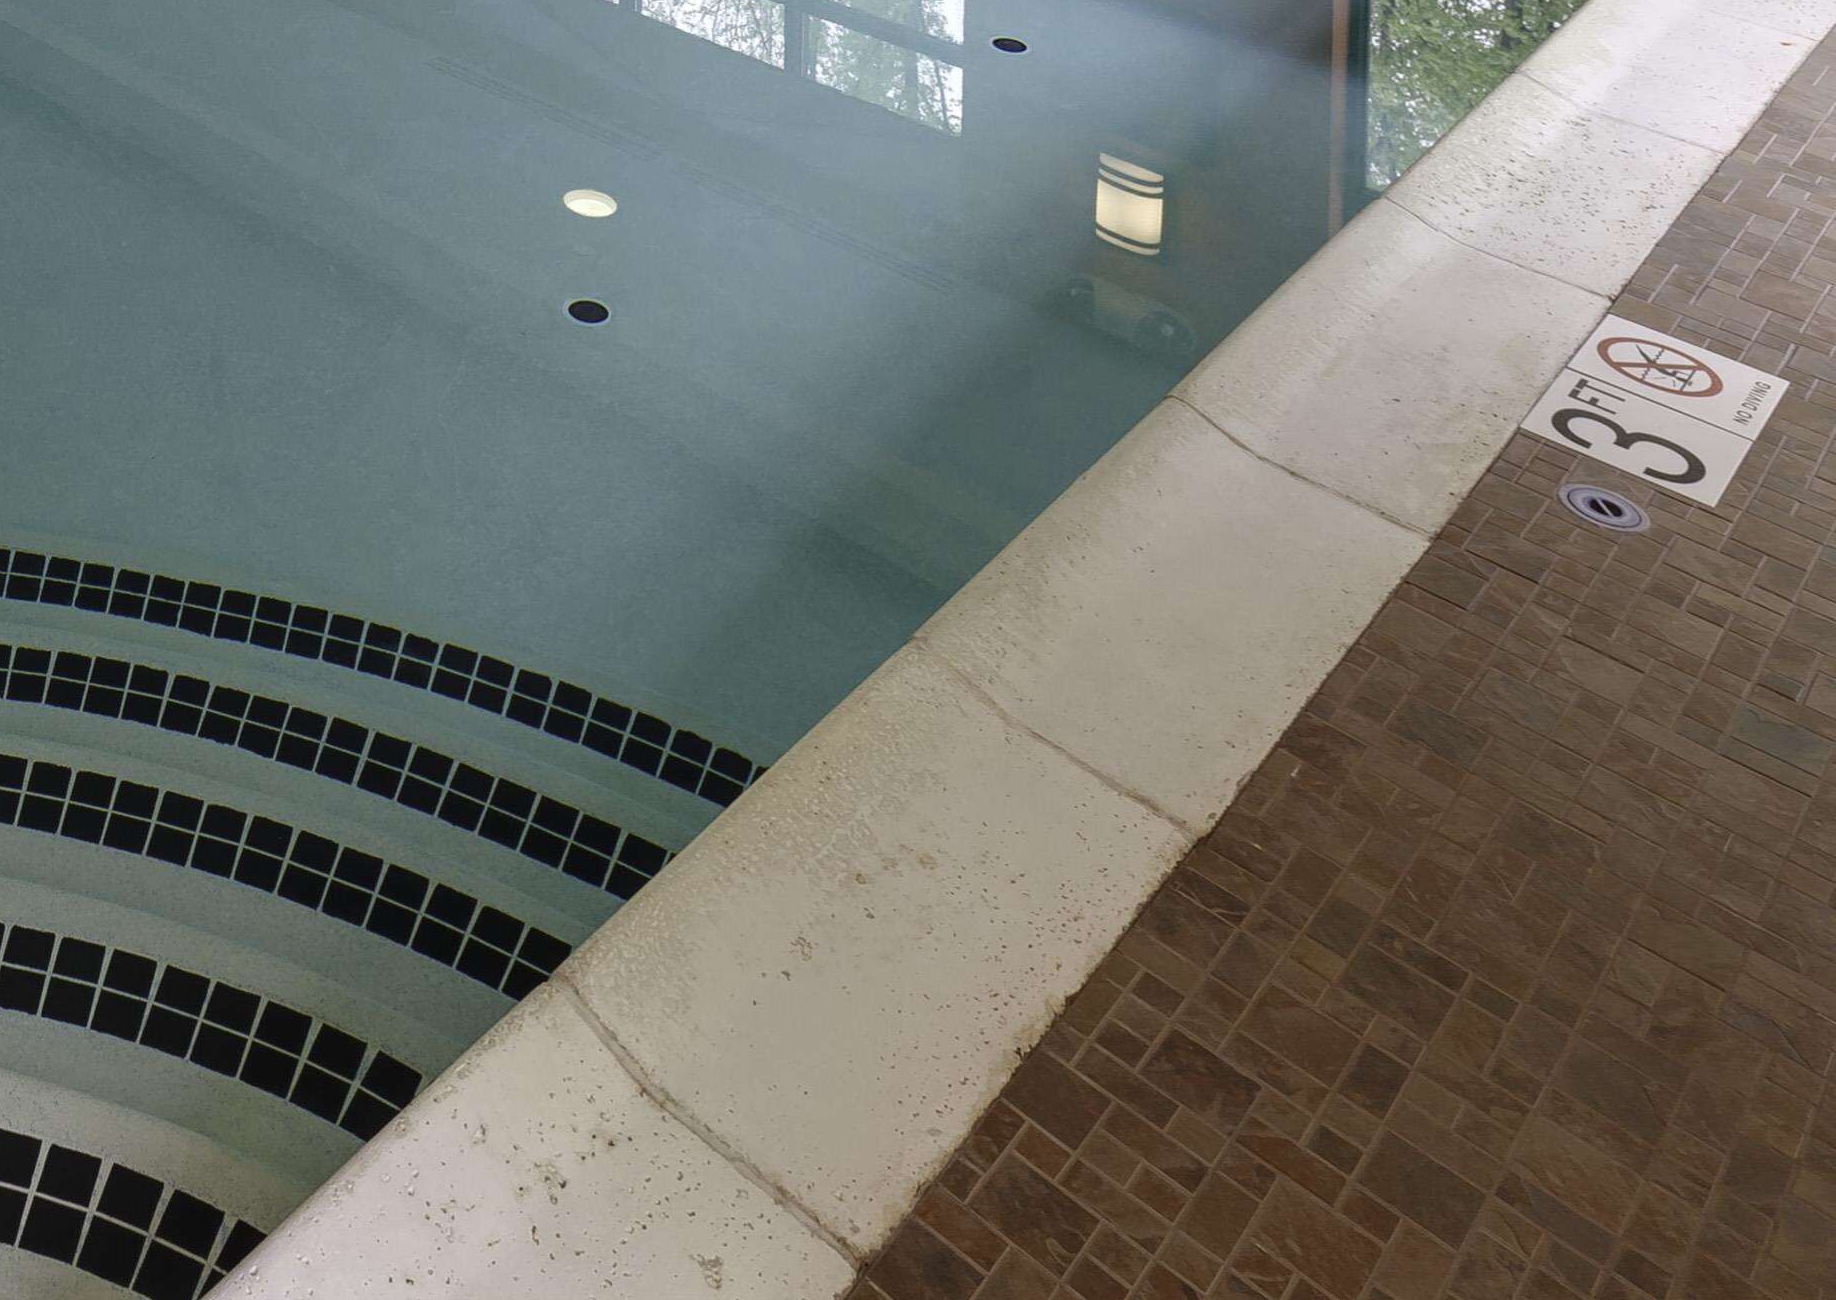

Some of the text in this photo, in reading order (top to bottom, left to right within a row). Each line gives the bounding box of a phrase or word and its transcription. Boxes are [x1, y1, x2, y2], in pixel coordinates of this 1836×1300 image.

[1550, 377, 1707, 485] 3 FT
[1733, 381, 1771, 426] NO DIVING
